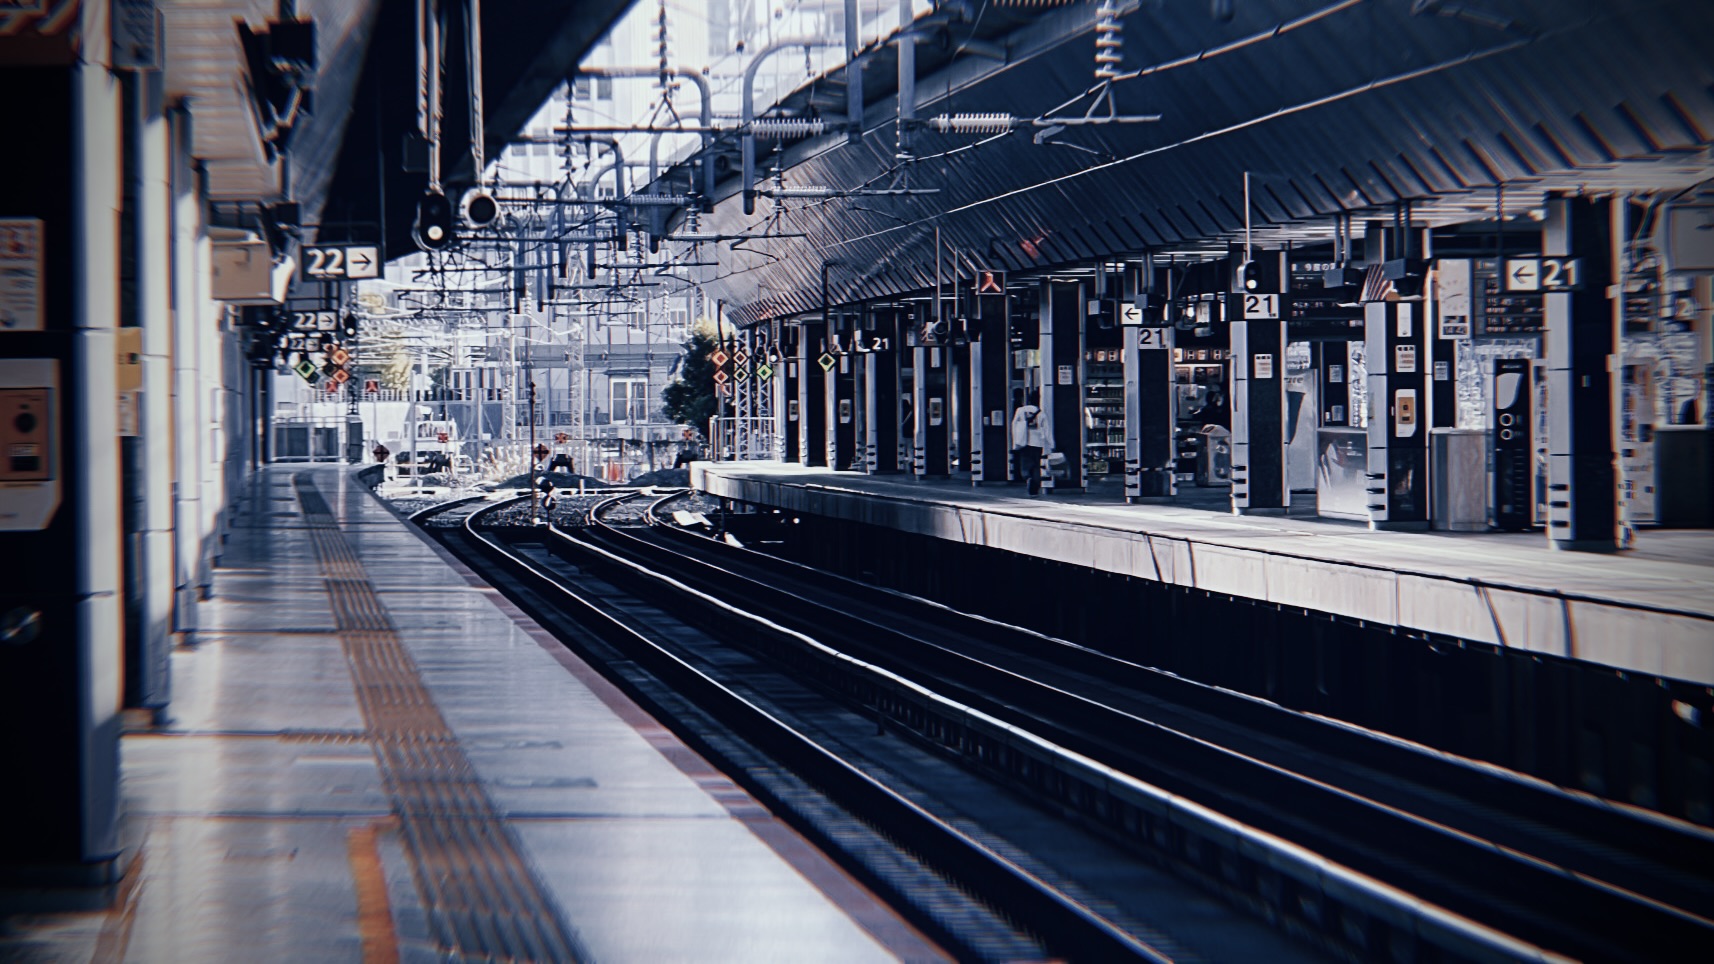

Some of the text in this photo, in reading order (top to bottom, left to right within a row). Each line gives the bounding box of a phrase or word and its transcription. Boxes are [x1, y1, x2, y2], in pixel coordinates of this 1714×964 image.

[306, 248, 345, 275] 22
[1542, 259, 1578, 287] 21
[1245, 295, 1273, 315] 21
[293, 312, 317, 328] 22
[289, 340, 305, 350] 22
[872, 337, 889, 350] 21
[1140, 328, 1164, 345] 21
